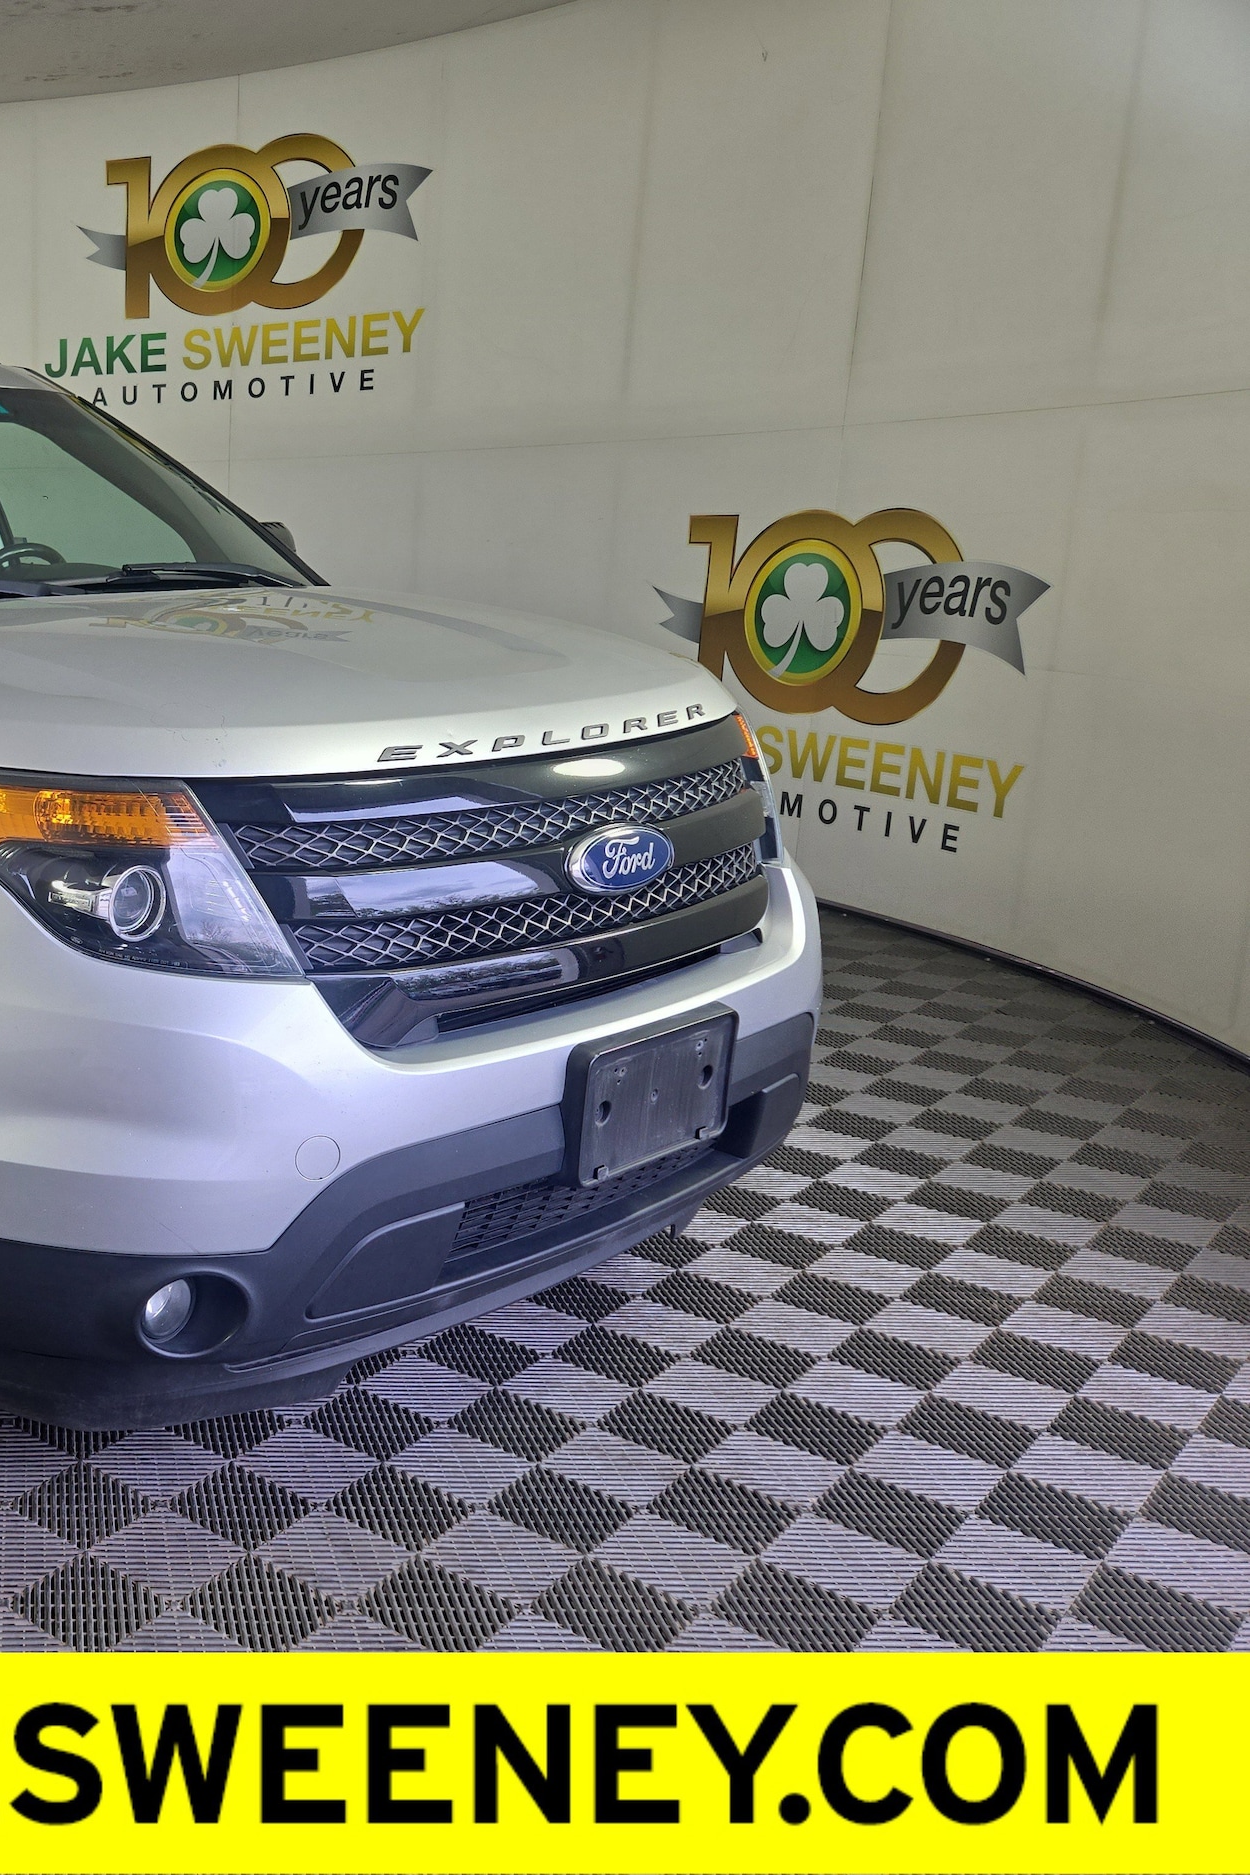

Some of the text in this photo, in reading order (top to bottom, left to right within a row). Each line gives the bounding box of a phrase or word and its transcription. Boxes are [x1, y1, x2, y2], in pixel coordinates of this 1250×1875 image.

[105, 132, 400, 320] 100 years
[45, 308, 426, 379] JAKE SWEENEY
[92, 368, 376, 407] AUTOMOTIVE
[890, 574, 1011, 631] years
[377, 702, 707, 764] EXPLORER
[759, 726, 1025, 819] SWEENEY
[779, 790, 960, 853] MOTIVE
[601, 837, 656, 881] Ford
